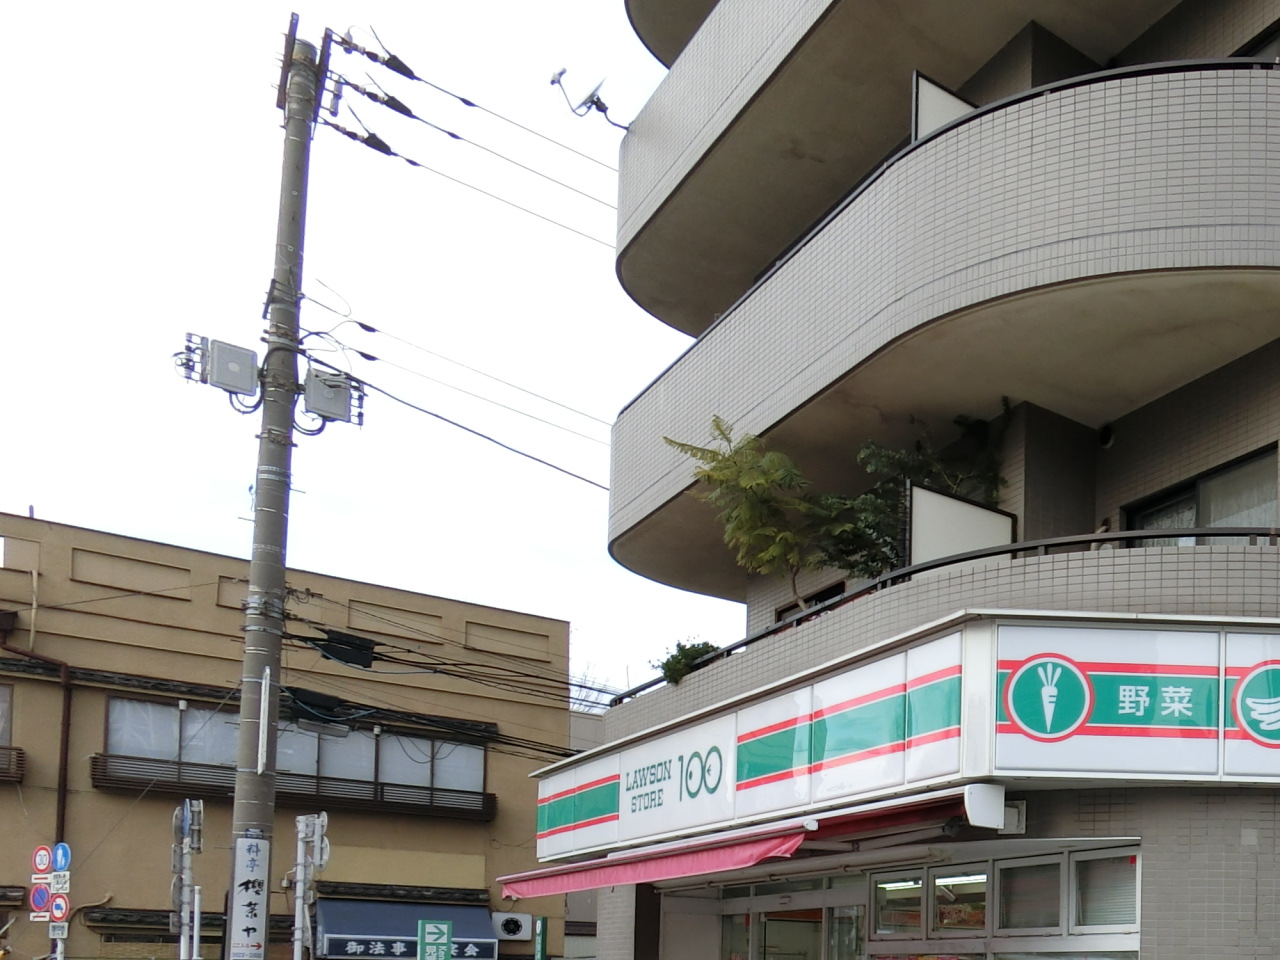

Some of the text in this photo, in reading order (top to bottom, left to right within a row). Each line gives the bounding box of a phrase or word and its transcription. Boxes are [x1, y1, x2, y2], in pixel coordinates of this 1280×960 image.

[1118, 685, 1193, 718] 野菜
[625, 745, 723, 802] LAWSON 100
[631, 788, 664, 814] STORE
[245, 842, 262, 873] 料亭
[345, 941, 408, 956] 御法事
